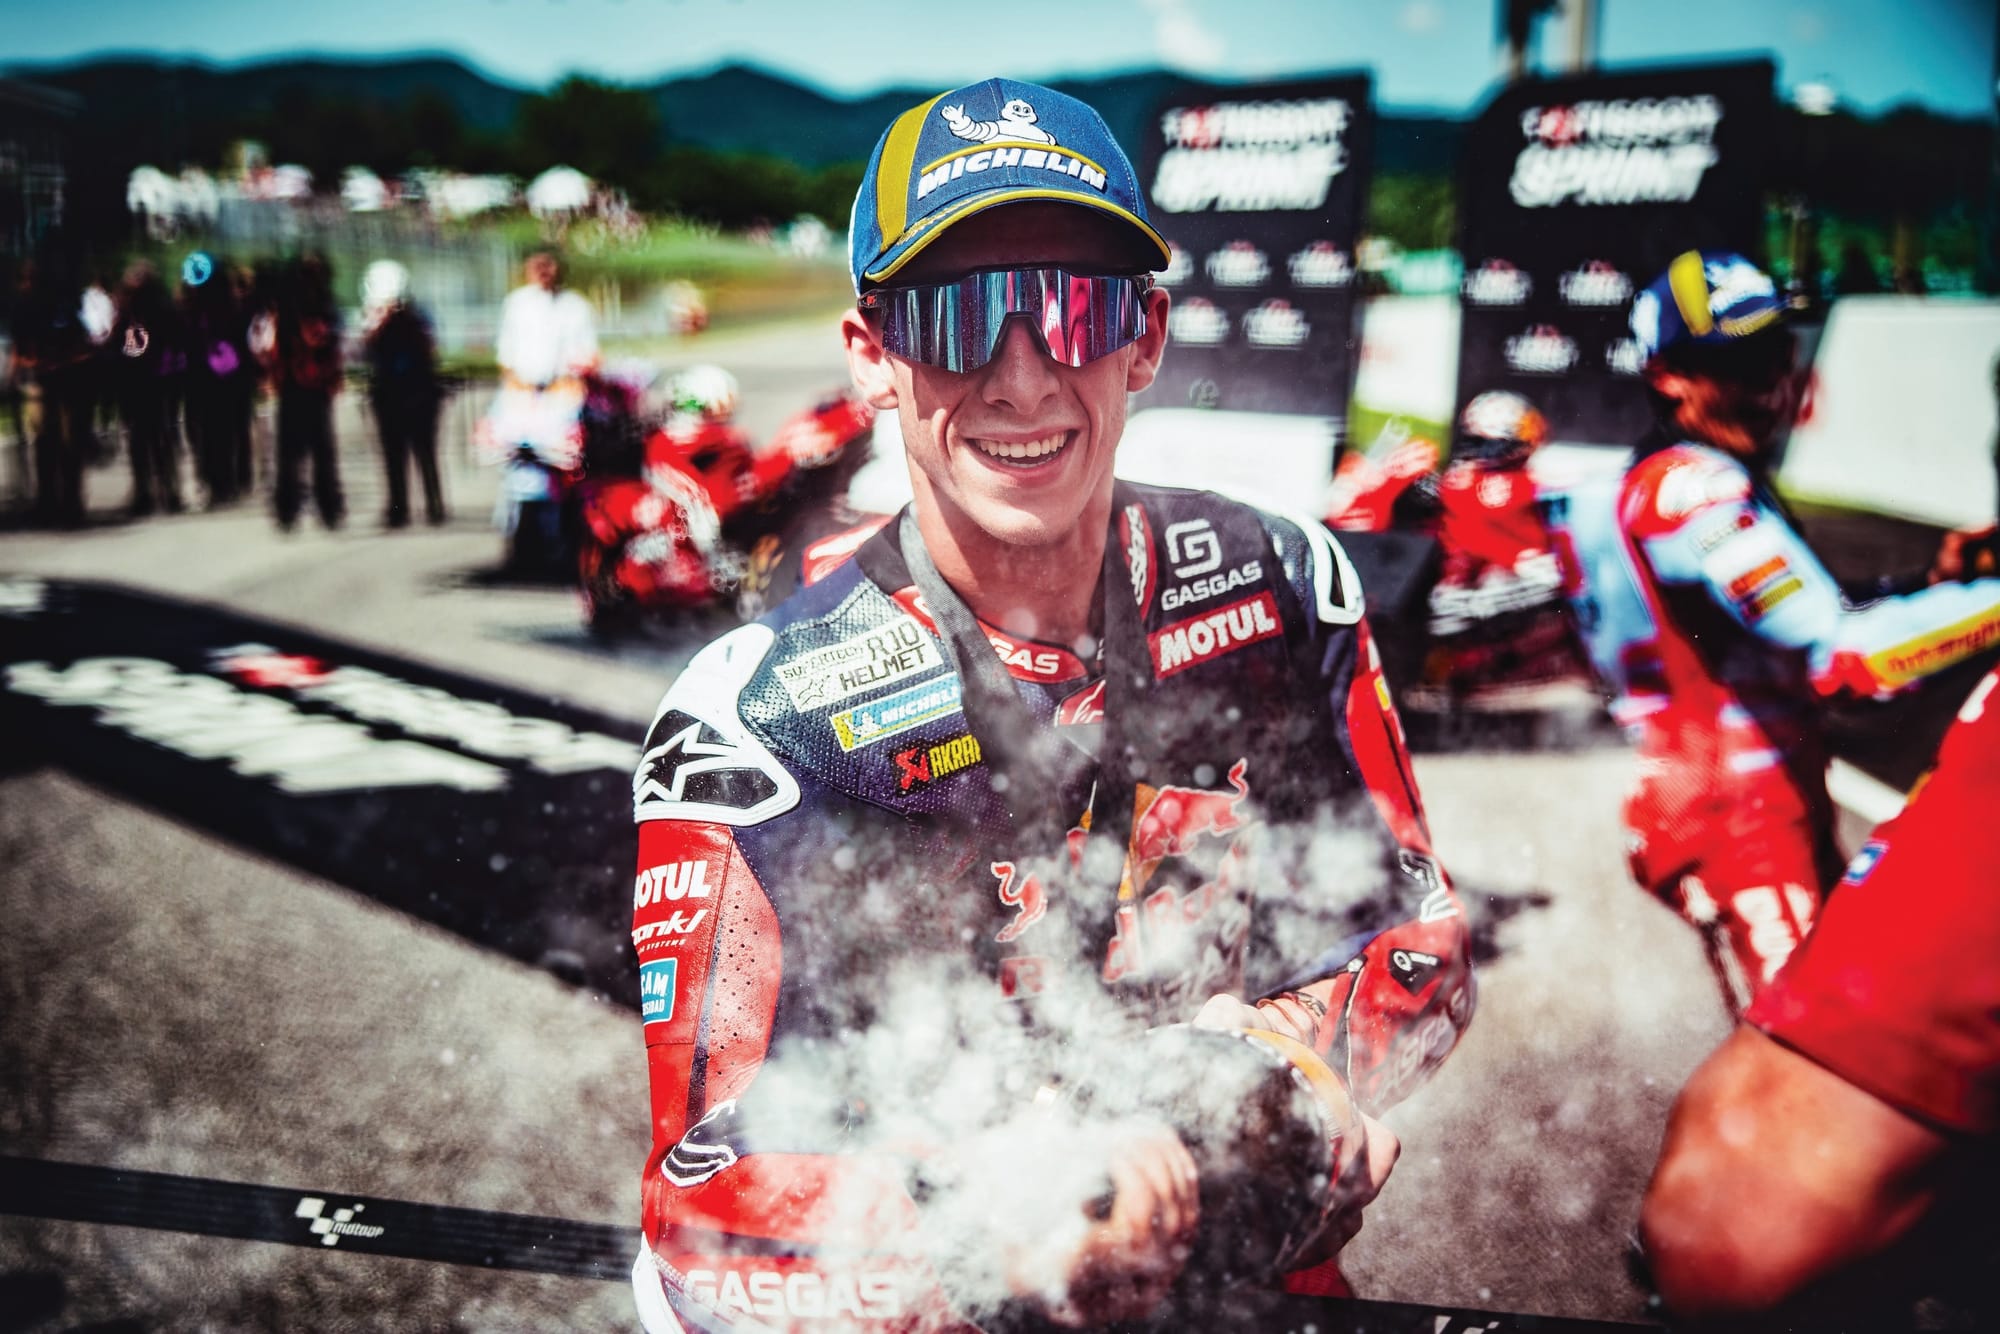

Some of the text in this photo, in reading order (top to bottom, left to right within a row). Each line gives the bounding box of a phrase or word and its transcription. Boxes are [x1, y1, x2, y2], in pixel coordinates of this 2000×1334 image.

[917, 148, 1106, 199] MICHELIN
[1161, 560, 1263, 611] GASGAS
[1159, 600, 1276, 672] MOTUL
[839, 644, 925, 691] HELMET
[880, 685, 960, 724] MICHELI
[686, 1270, 900, 1318] GASGAS
